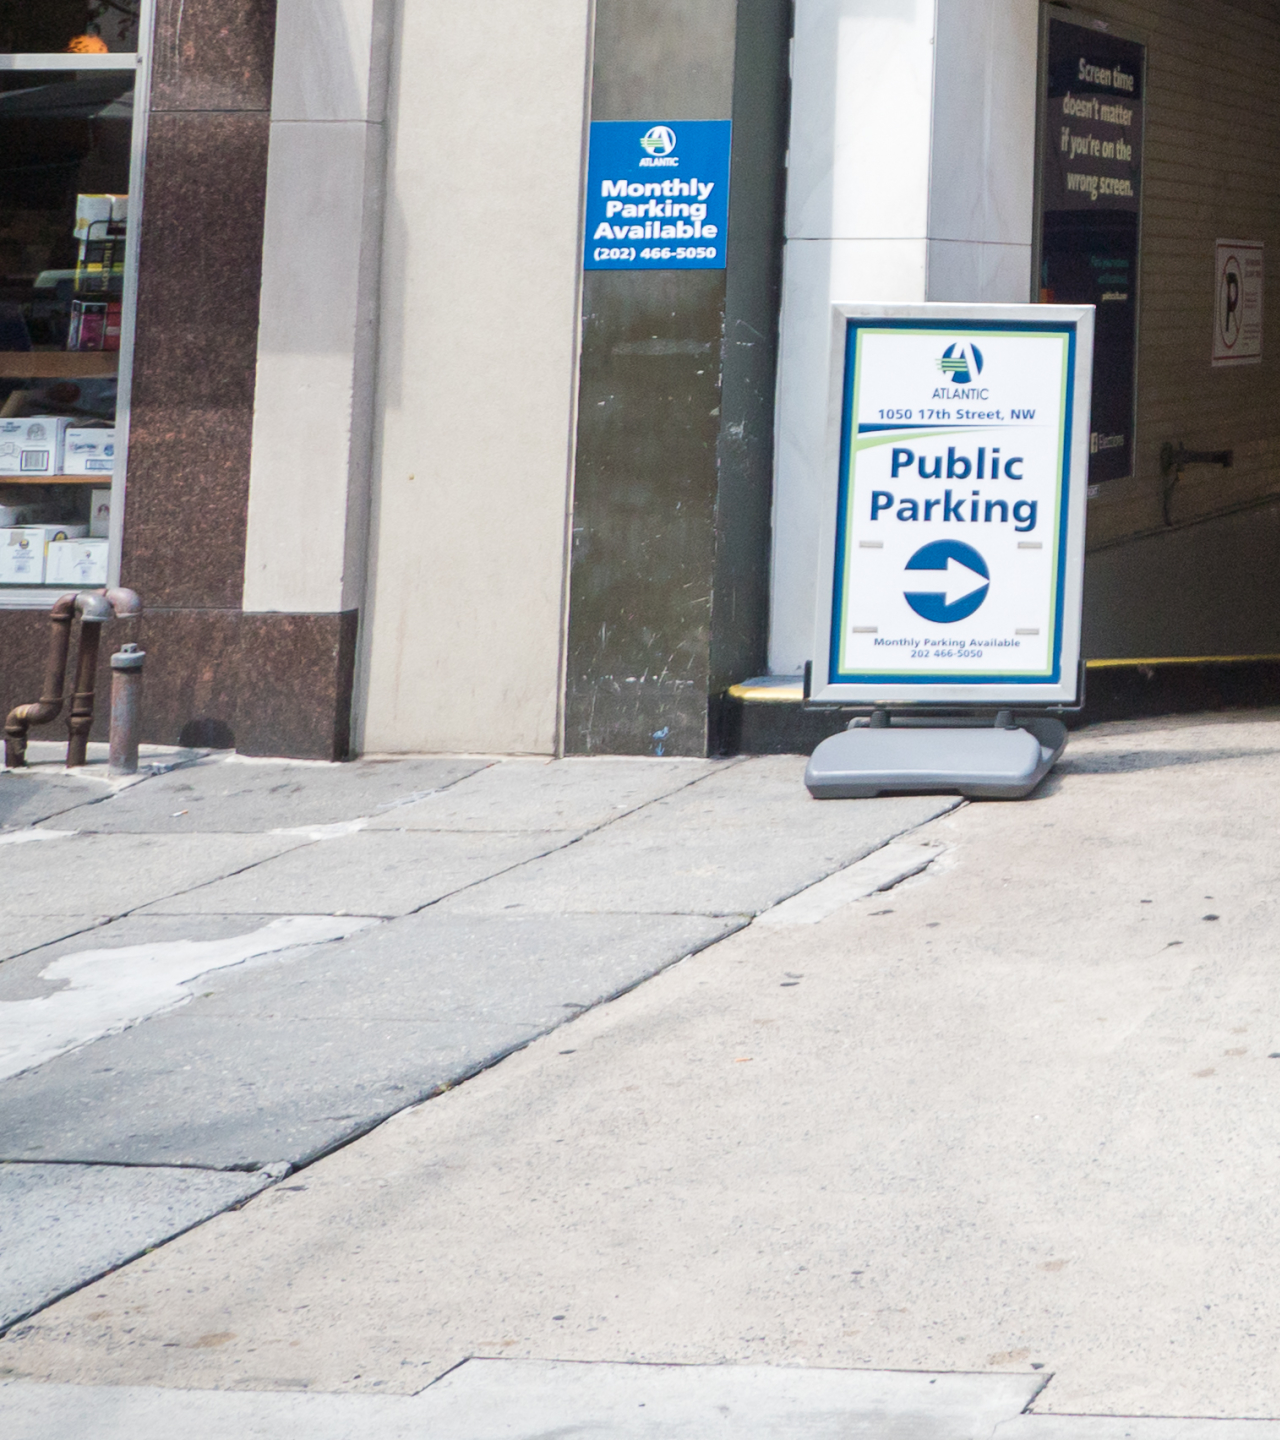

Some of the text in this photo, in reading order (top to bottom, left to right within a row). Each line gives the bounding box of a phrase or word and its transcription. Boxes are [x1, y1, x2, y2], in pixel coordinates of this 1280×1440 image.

[1078, 57, 1134, 92] Screen time
[1062, 90, 1133, 126] doesn't matter
[1061, 126, 1132, 161] if you're on the
[639, 157, 679, 167] ATLANTIC
[601, 178, 714, 200] Monthly
[1067, 172, 1133, 201] wrong screen.
[606, 199, 707, 221] Parking
[593, 220, 718, 240] Available
[593, 247, 716, 261] (202) 466-5050
[932, 388, 989, 400] ATLANTIC
[878, 409, 1036, 421] 1050 17th Street, NW
[891, 447, 1024, 480] Public
[870, 489, 1038, 532] Parking
[874, 638, 1020, 649] Monthly Parking Available
[911, 649, 982, 658] 202 466-5050
